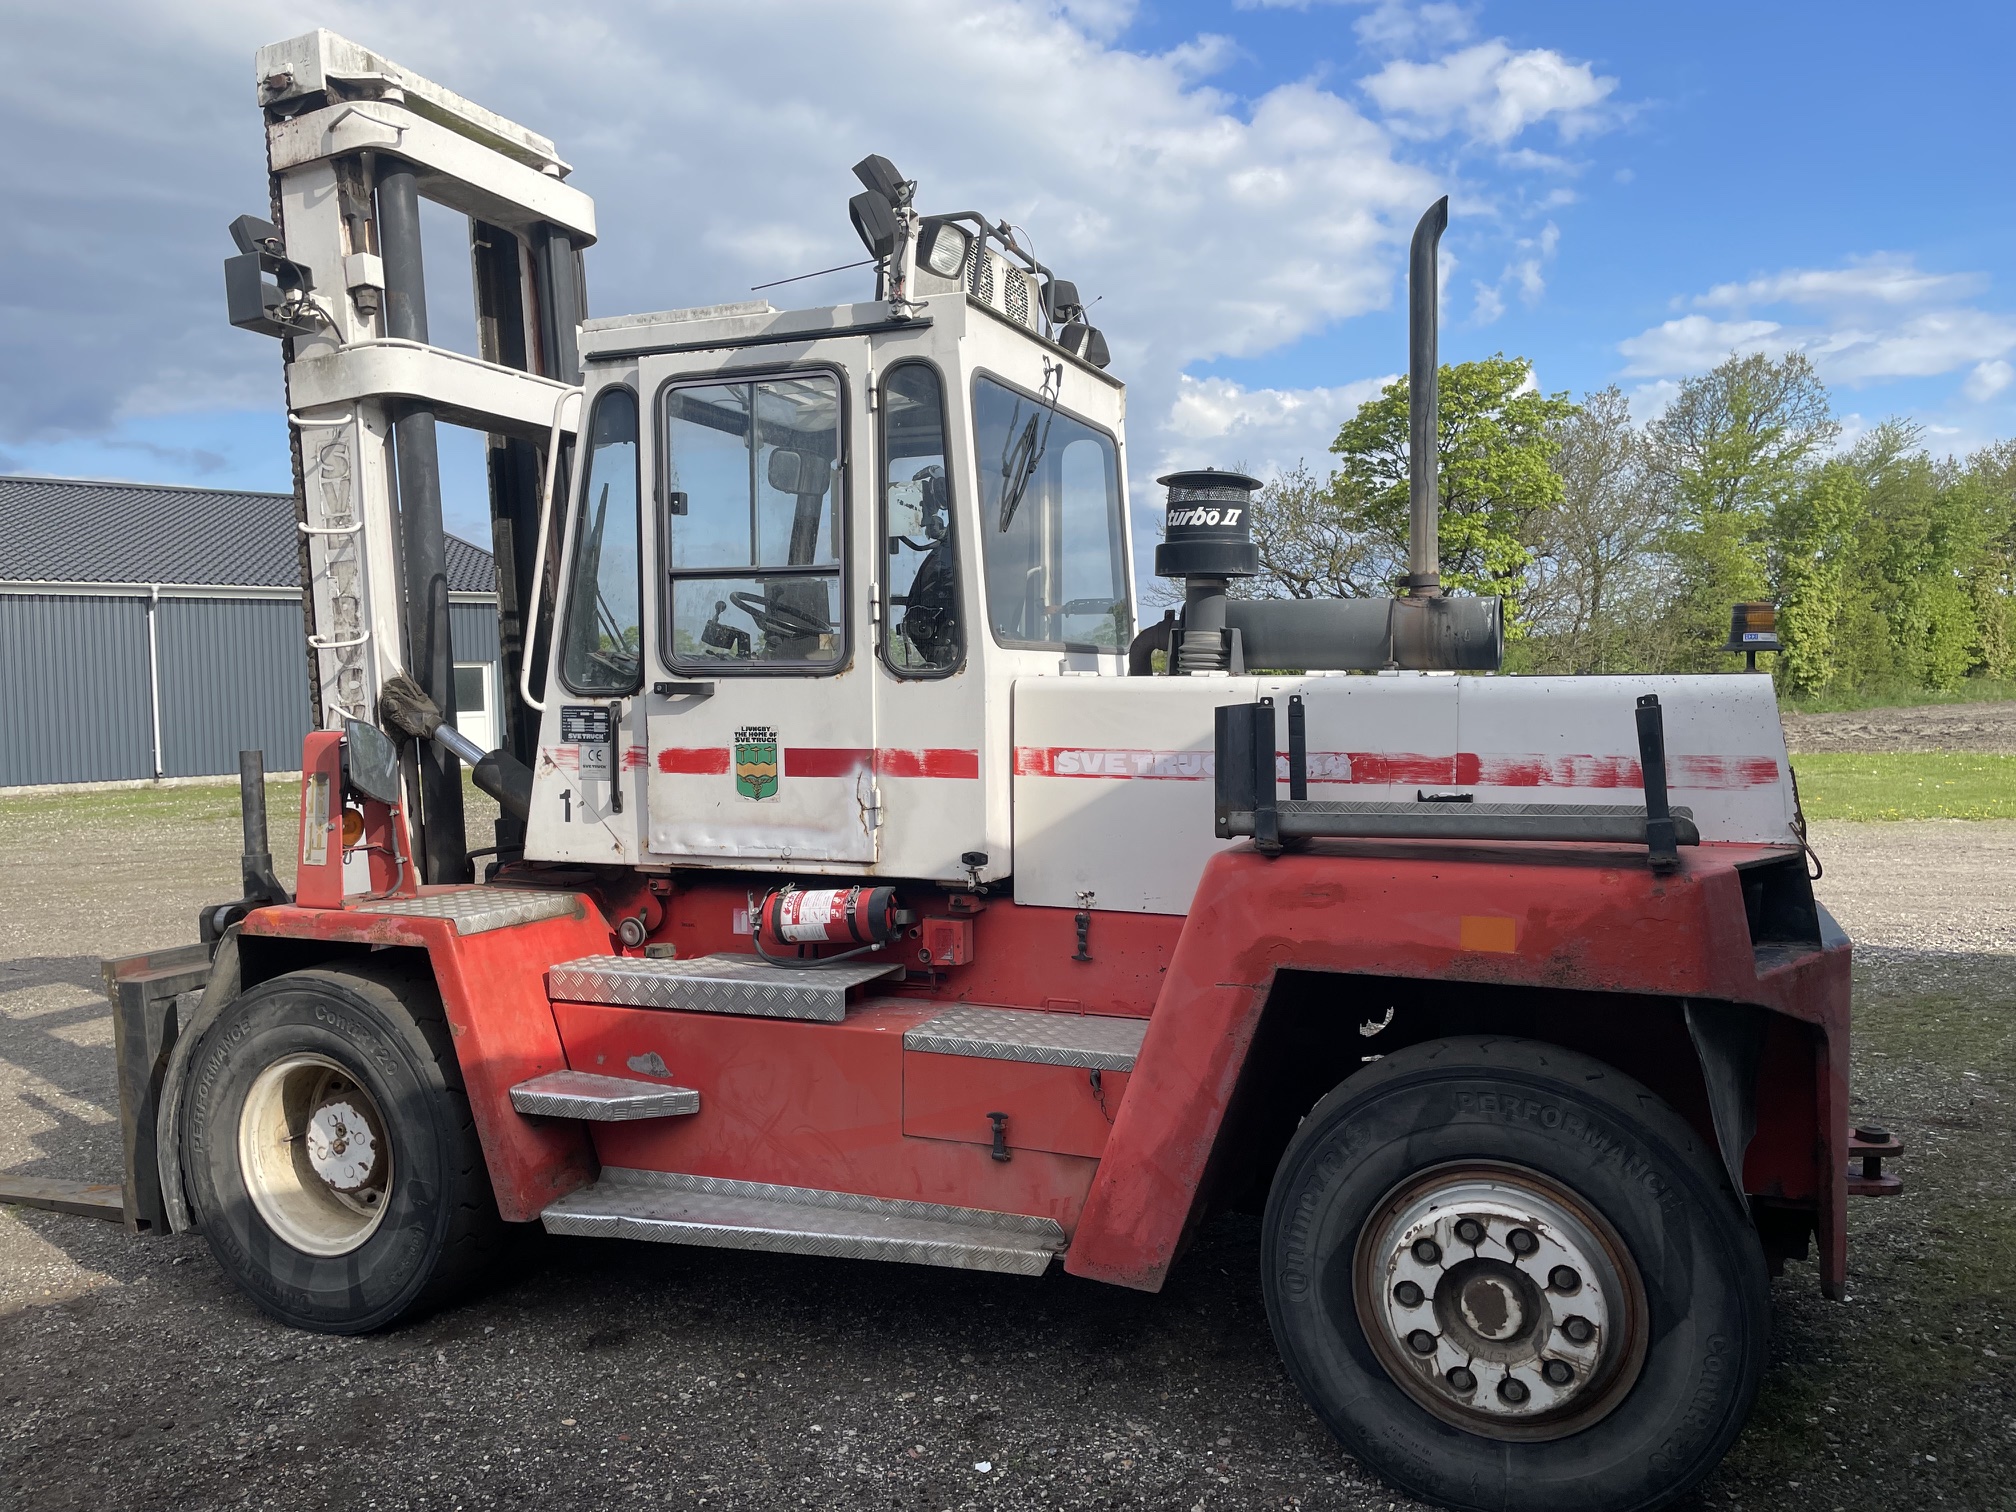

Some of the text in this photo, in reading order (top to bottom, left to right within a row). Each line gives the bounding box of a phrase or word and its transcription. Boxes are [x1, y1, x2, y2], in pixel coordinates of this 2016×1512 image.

[588, 749, 602, 762] CE
[559, 788, 571, 823] 1
[315, 1003, 400, 1077] ContiRT20
[192, 1016, 252, 1154] PERFORMANCE
[1455, 1090, 1685, 1214] PERFORMANCE
